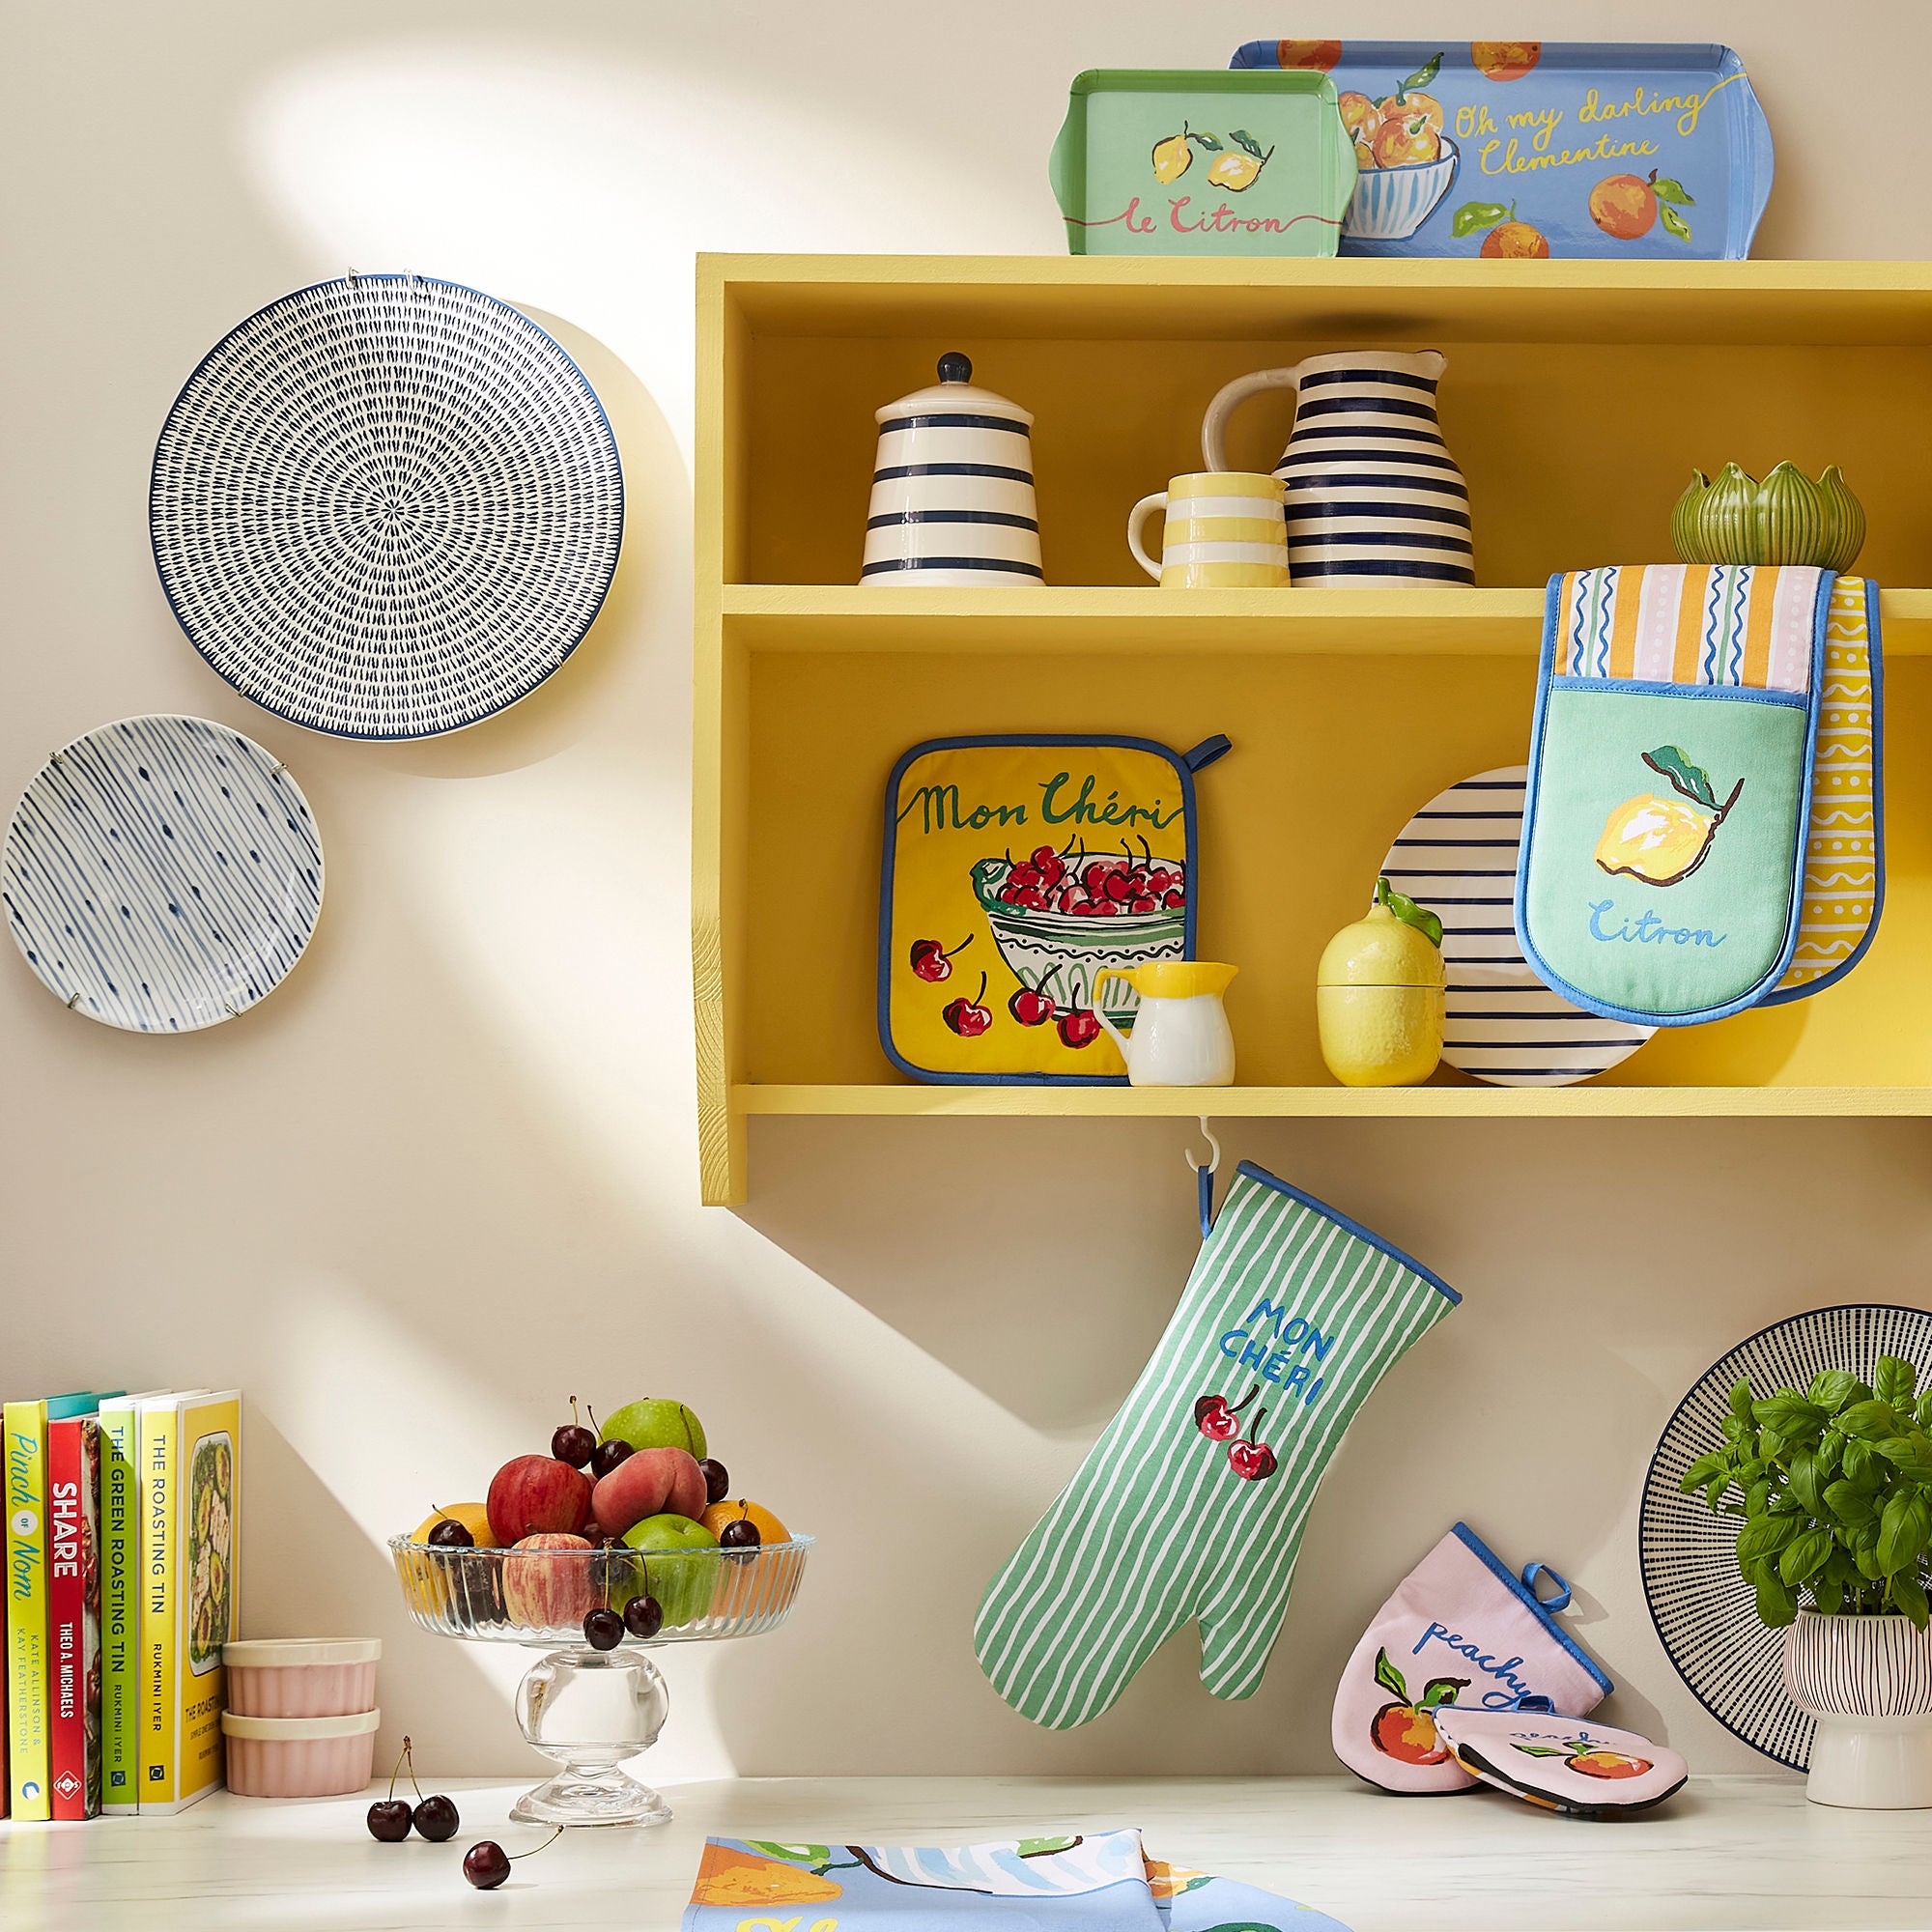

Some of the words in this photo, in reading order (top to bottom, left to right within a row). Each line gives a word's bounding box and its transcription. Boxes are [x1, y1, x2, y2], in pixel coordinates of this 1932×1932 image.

[1455, 103, 1497, 138] Oh
[1505, 102, 1563, 150] my
[1578, 84, 1716, 136] darling
[1478, 133, 1661, 175] Clementine
[1168, 196, 1300, 234] Citron
[904, 784, 1028, 835] Mon
[1037, 772, 1177, 830] Chéri
[1587, 898, 1727, 948] Citron
[1246, 1297, 1335, 1362] MON
[1219, 1328, 1324, 1406] CHÉRI
[111, 1426, 125, 1463] THE
[152, 1435, 166, 1470] THE
[10, 1433, 42, 1508] Pinch
[20, 1518, 29, 1528] OF
[111, 1467, 125, 1532] GREEN
[52, 1482, 78, 1578] SHARE
[152, 1478, 166, 1576] ROASTING
[13, 1540, 42, 1602] Nom
[111, 1539, 126, 1635] ROASTING
[152, 1582, 165, 1613] TIN
[16, 1628, 26, 1652] KAY
[30, 1634, 40, 1665] KATE
[59, 1622, 73, 1650] THEO
[59, 1652, 73, 1663] A.
[111, 1641, 125, 1672] TIN
[153, 1643, 162, 1697] RUKMINI
[1411, 1622, 1532, 1709] peachy
[17, 1657, 28, 1754] FEATHERSTONE
[31, 1670, 42, 1734] ALLINSON
[60, 1668, 74, 1719] MICHAELS
[113, 1684, 123, 1732] RUKMINI
[153, 1702, 162, 1732] IYER
[113, 1737, 123, 1763] IYER
